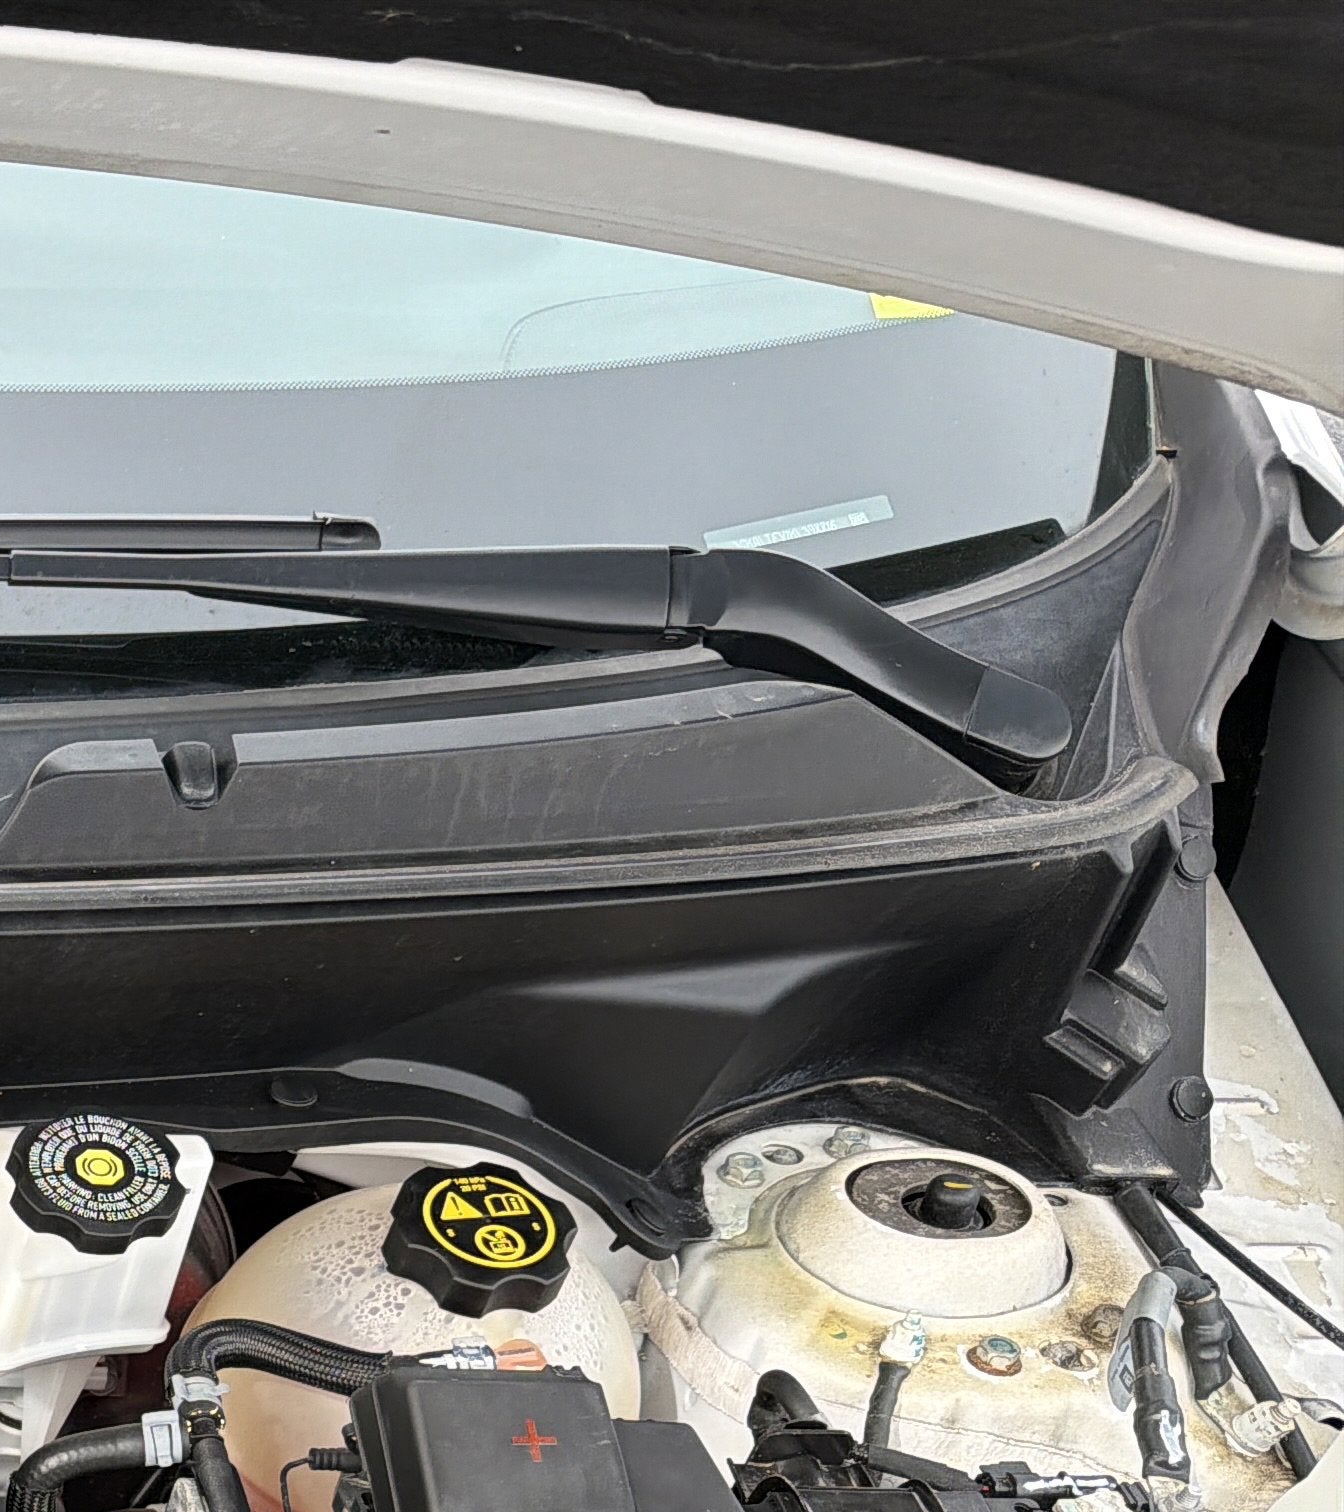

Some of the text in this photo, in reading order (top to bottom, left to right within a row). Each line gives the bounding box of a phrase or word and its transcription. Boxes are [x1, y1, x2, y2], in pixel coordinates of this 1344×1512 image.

[74, 1115, 86, 1125] LE
[87, 1114, 128, 1130] BOUCHON
[127, 1125, 154, 1145] AVANT
[149, 1141, 162, 1154] LA
[75, 1124, 88, 1133] DU
[122, 1132, 135, 1144] DE
[101, 1133, 128, 1150] BIDON
[46, 1175, 61, 1188] CAP
[56, 1186, 87, 1207] BEFORE
[130, 1193, 148, 1205] USE
[97, 1191, 125, 1202] CLEAN
[123, 1176, 145, 1198] FILLER
[48, 1192, 73, 1211] FLUID
[72, 1205, 98, 1220] FROM
[98, 1211, 106, 1221] A
[106, 1208, 140, 1222] SEALED
